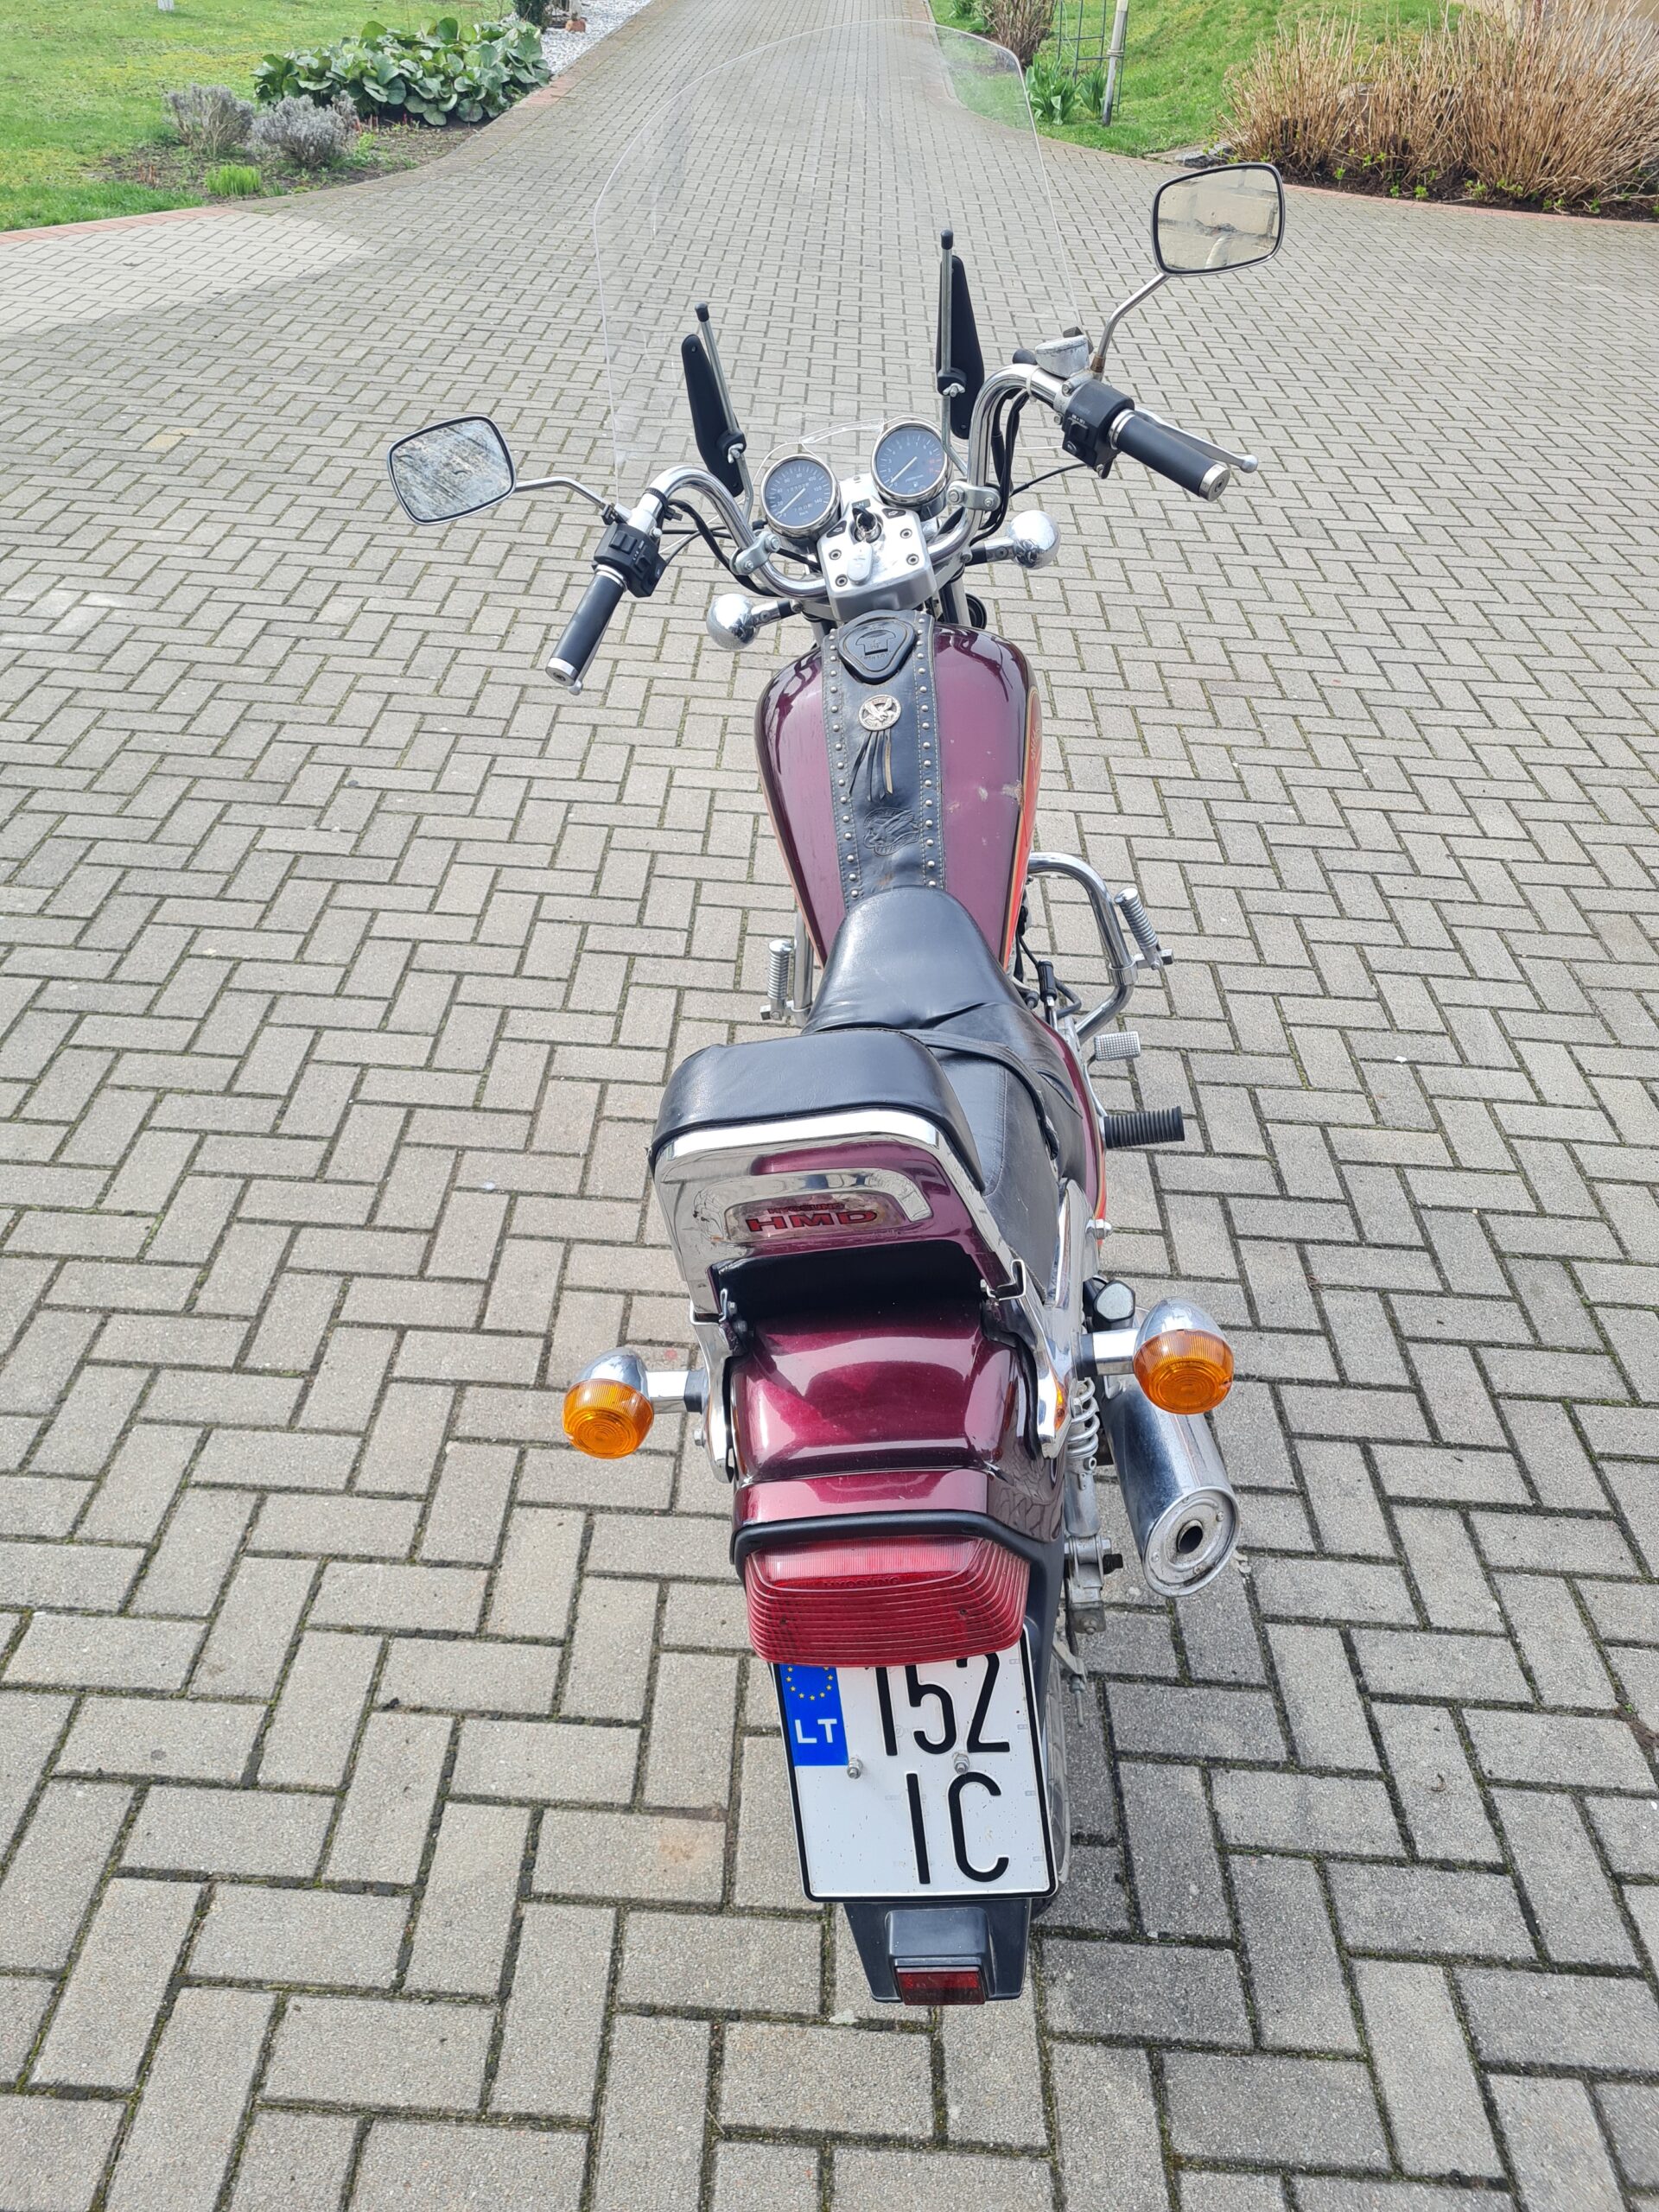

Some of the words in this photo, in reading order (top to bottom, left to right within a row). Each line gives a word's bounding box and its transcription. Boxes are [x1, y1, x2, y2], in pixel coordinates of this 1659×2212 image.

[745, 1210, 878, 1232] HMD
[767, 1203, 846, 1215] HYOSUNG
[865, 1652, 1010, 1757] 152
[794, 1718, 837, 1744] LT
[906, 1771, 1009, 1885] IC
